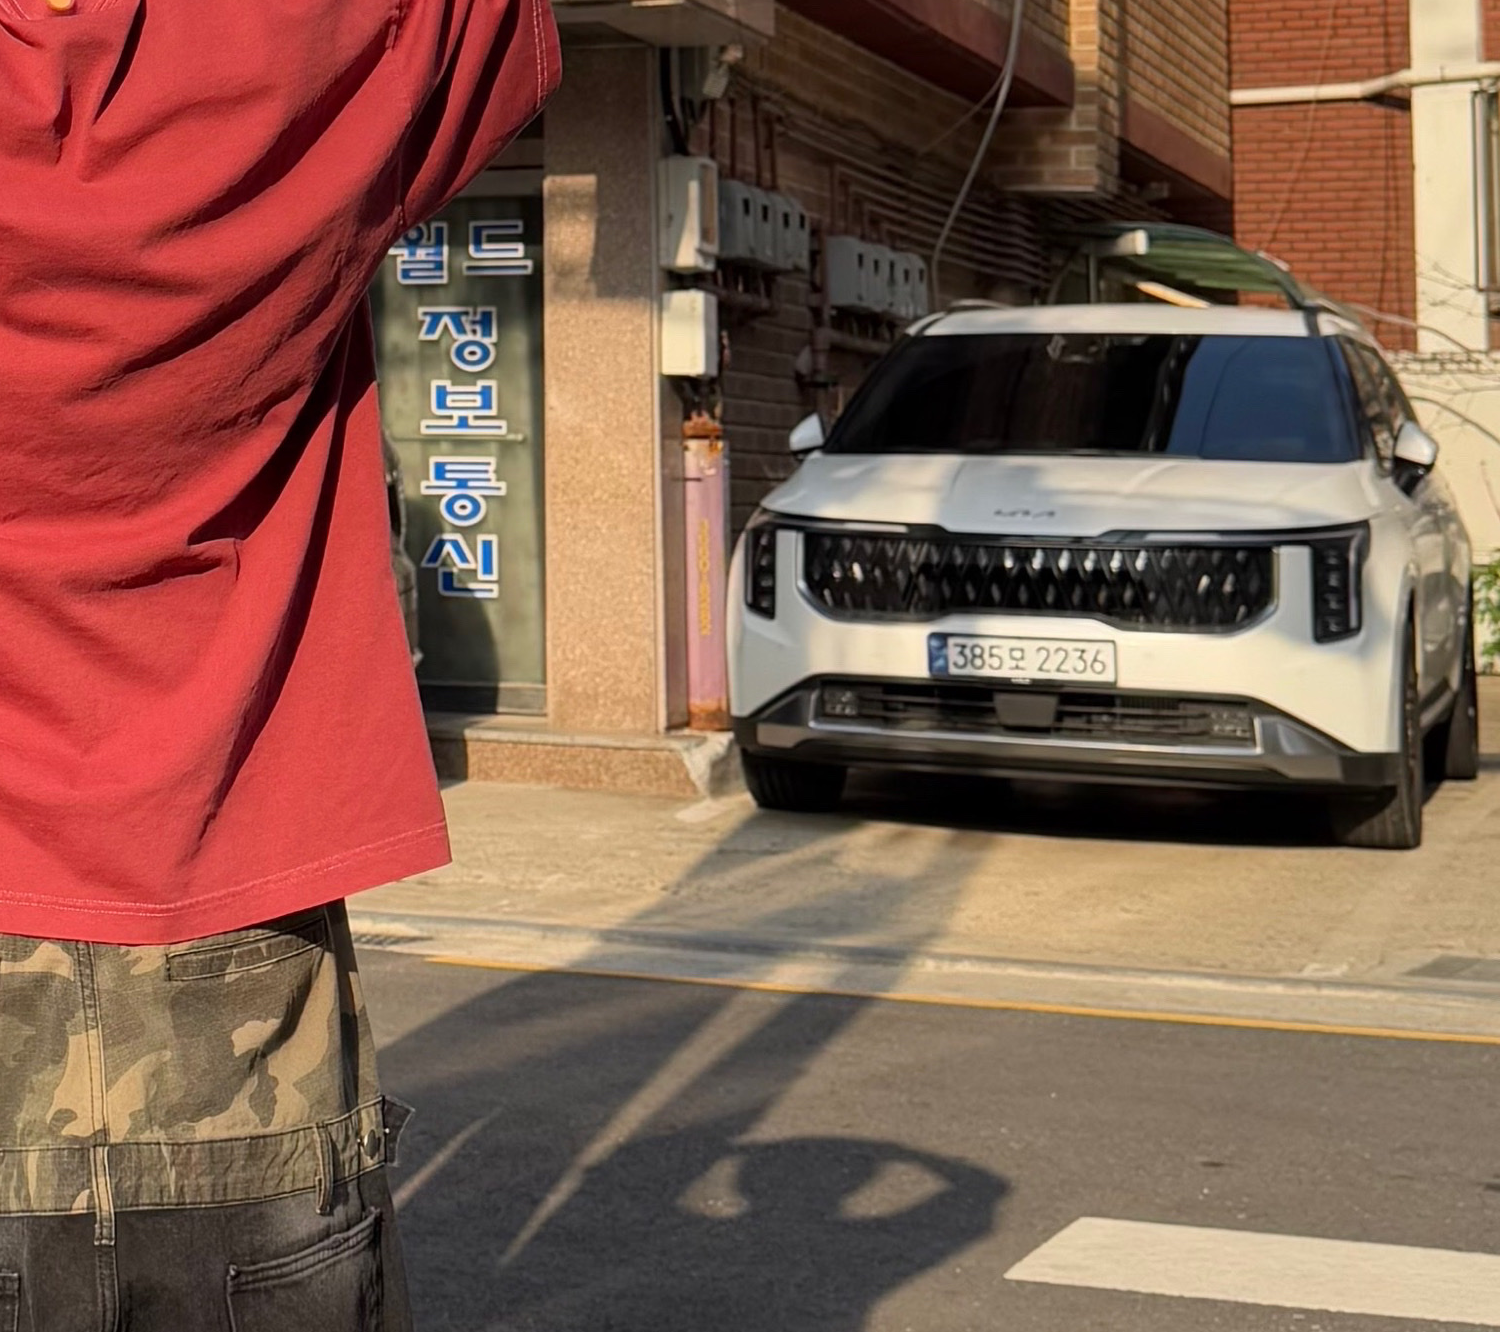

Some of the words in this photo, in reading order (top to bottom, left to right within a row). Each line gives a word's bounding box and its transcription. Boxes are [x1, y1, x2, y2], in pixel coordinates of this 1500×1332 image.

[388, 219, 534, 284] 월드
[417, 306, 508, 599] 정보통신
[951, 643, 1027, 671] 385모
[1035, 646, 1107, 674] 2236
